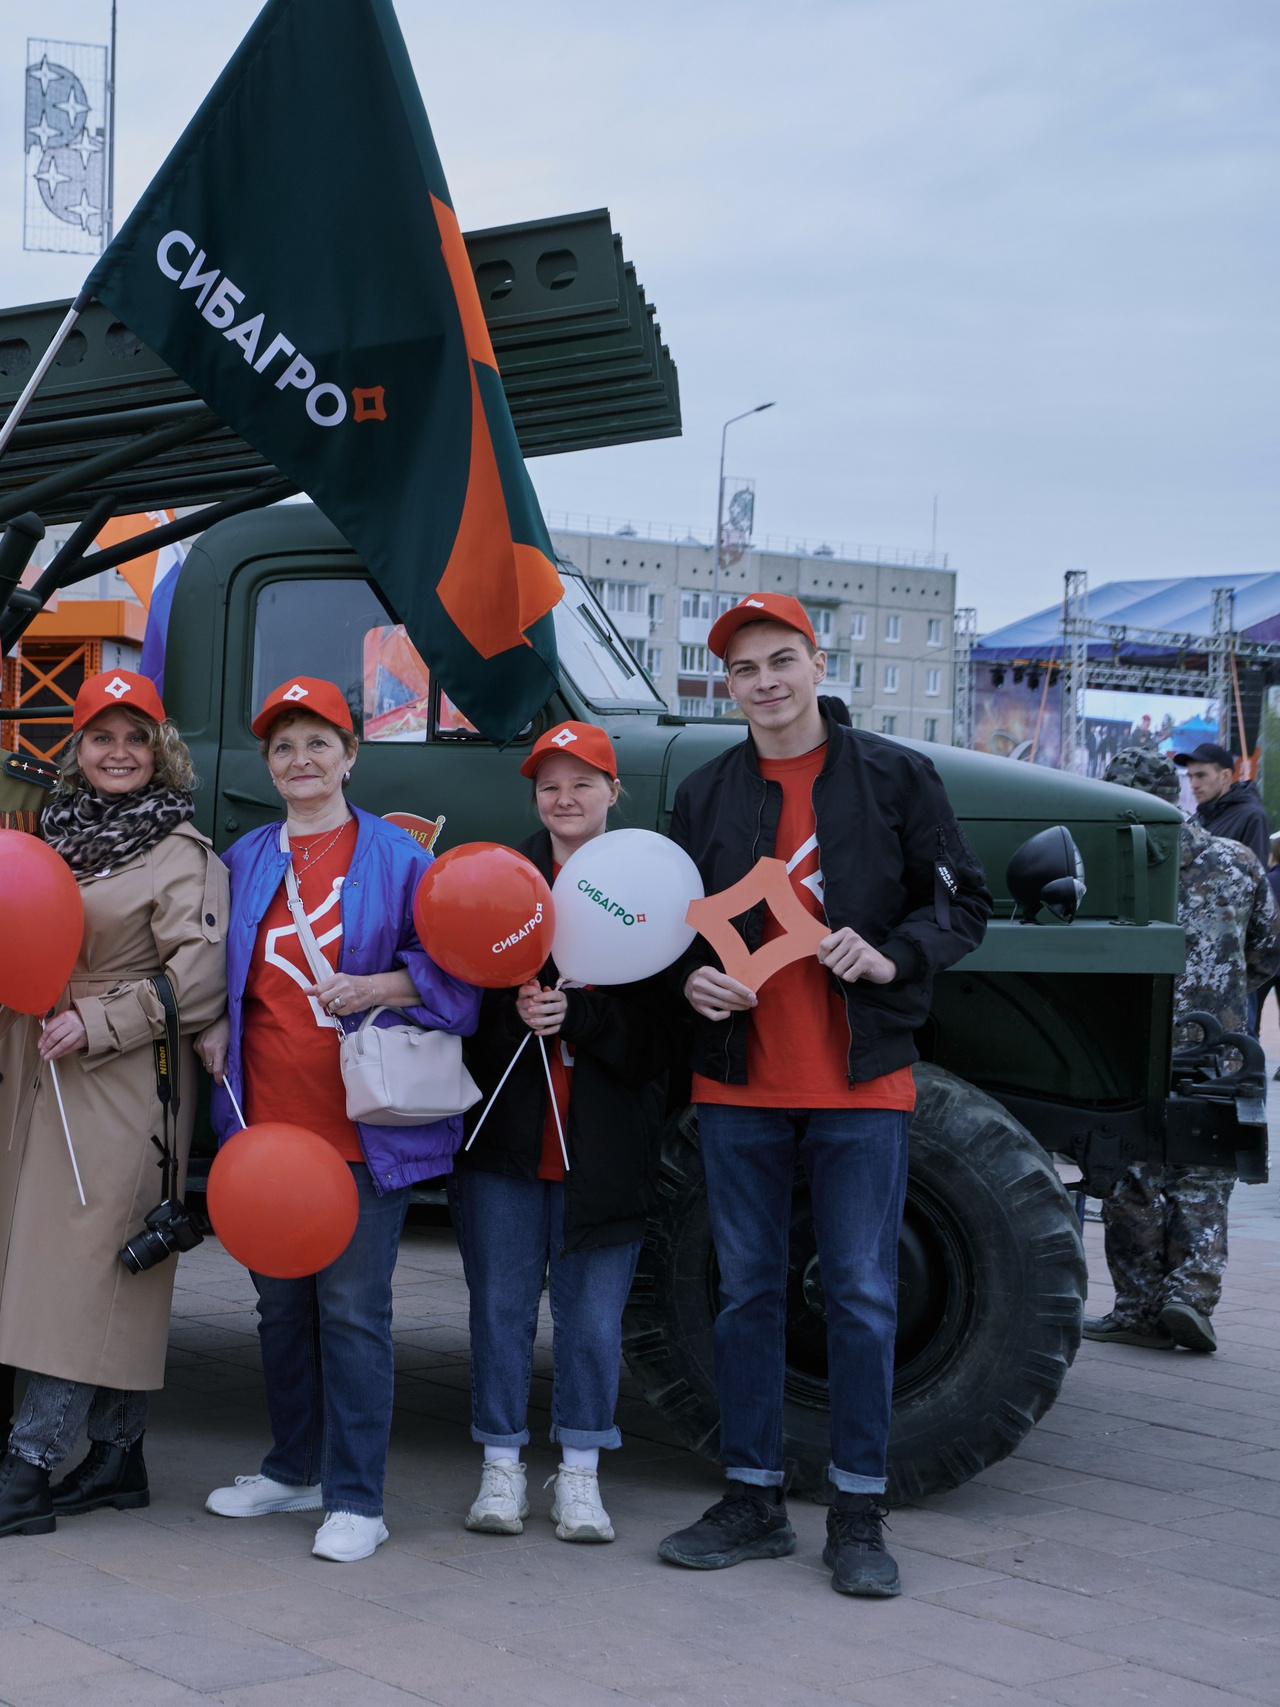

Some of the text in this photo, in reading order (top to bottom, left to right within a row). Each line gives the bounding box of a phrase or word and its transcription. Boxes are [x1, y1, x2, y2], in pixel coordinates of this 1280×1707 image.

[157, 230, 347, 427] СИБАГРО
[577, 880, 635, 926] СИБАГРО
[492, 912, 542, 953] СИБАГРО
[159, 1046, 168, 1075] Nikon
